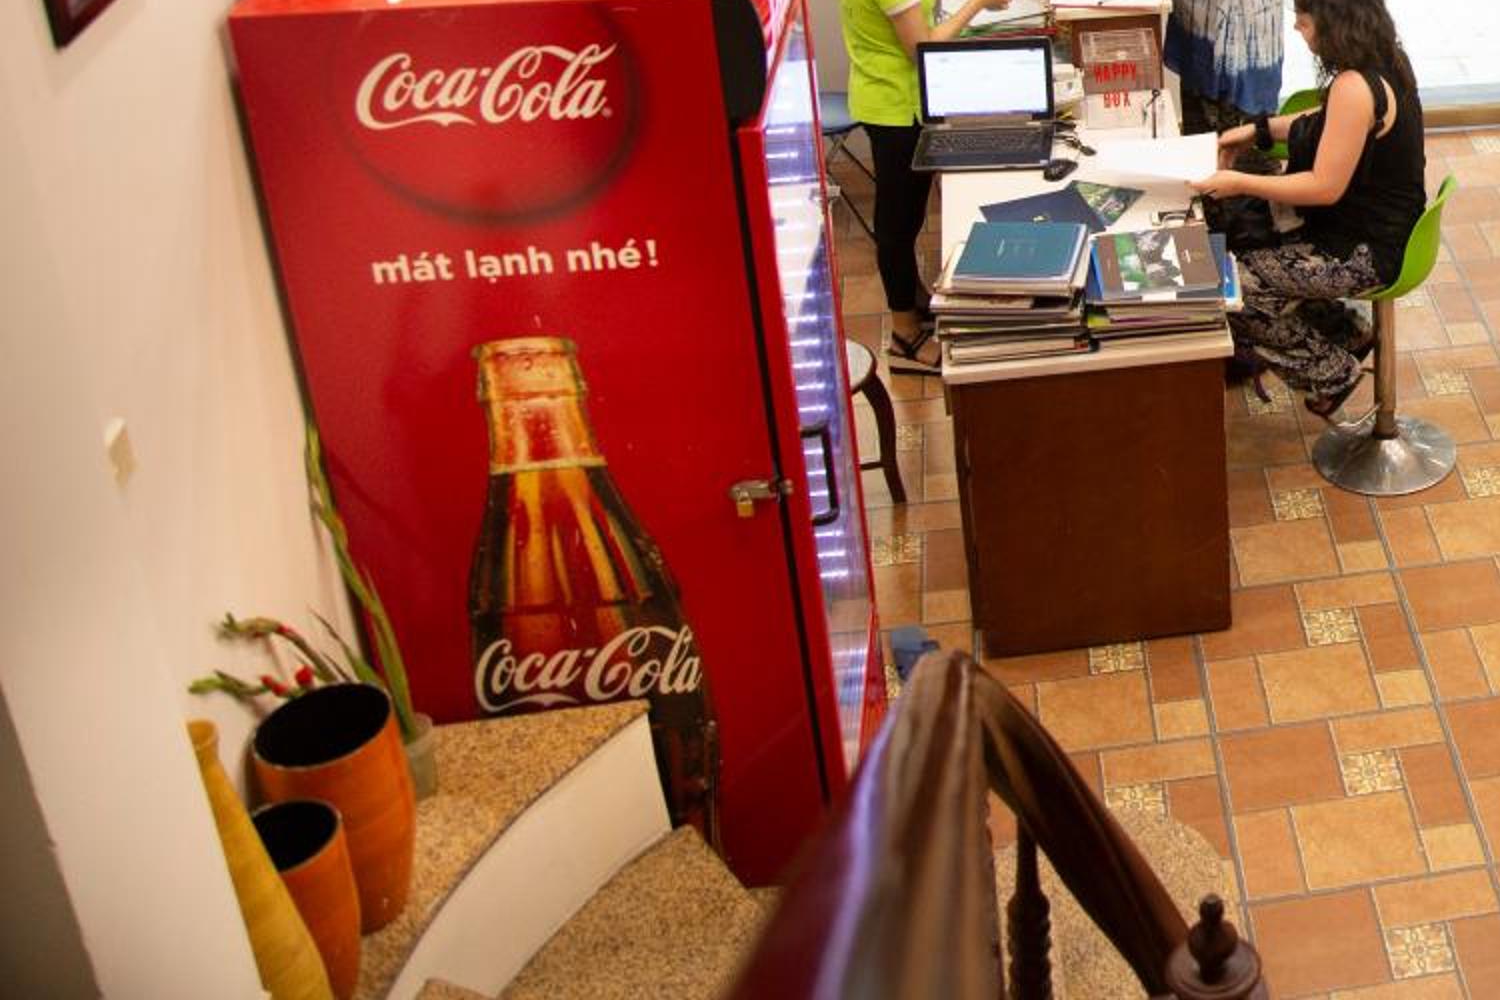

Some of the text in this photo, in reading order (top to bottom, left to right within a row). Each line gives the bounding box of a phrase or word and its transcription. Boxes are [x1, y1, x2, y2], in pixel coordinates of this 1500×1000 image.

[355, 42, 617, 131] Coca-Cola
[1093, 60, 1137, 84] HAPPY
[372, 251, 454, 284] mát
[465, 245, 554, 284] lạnh
[475, 624, 702, 713] Coca-Cola
